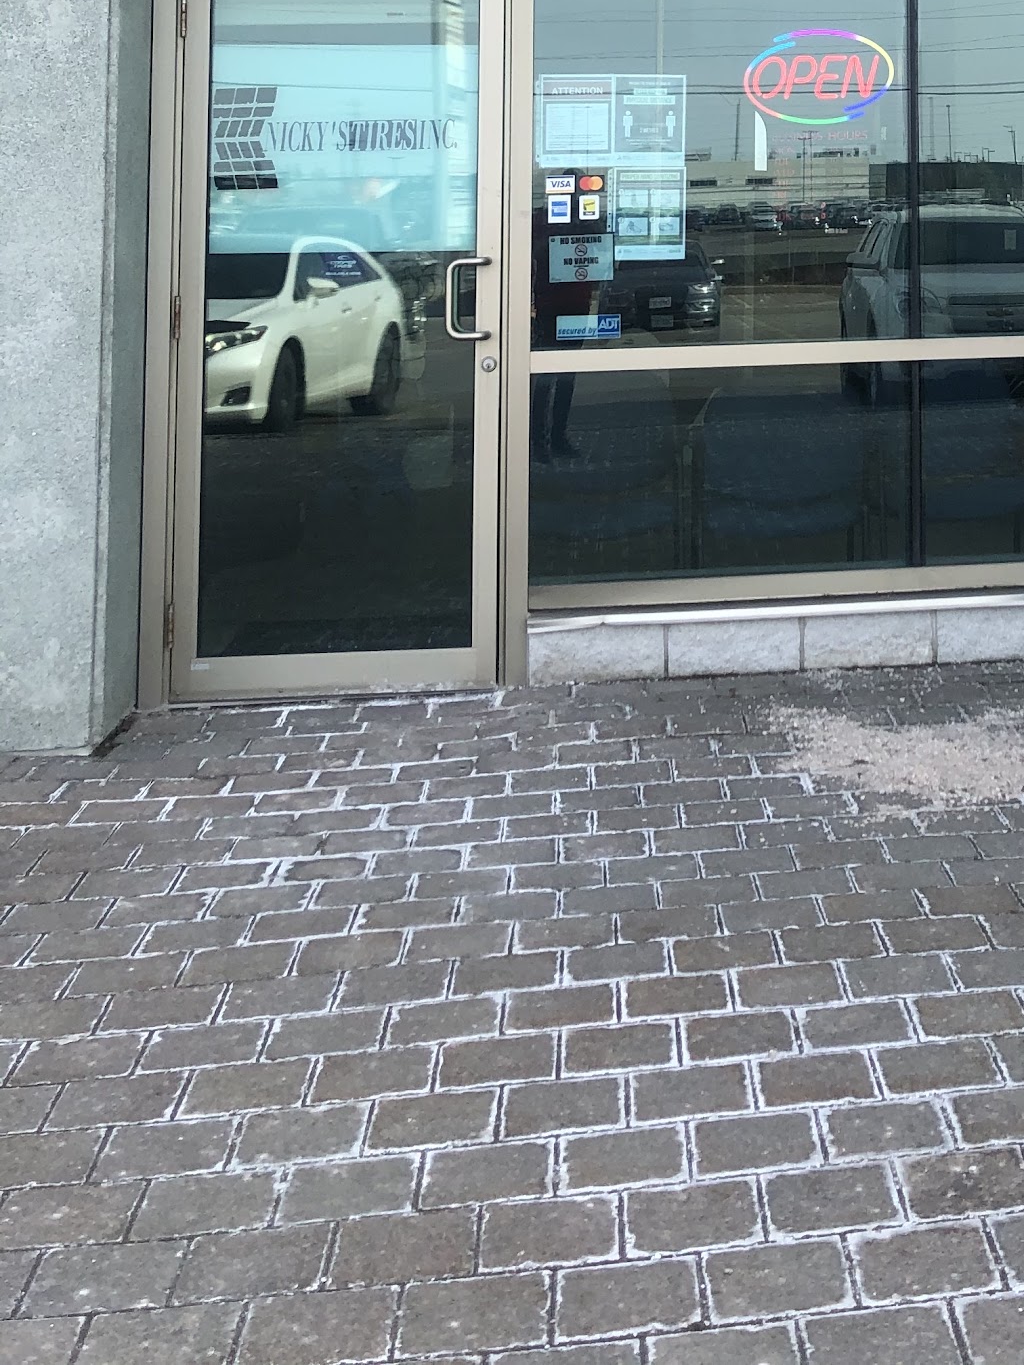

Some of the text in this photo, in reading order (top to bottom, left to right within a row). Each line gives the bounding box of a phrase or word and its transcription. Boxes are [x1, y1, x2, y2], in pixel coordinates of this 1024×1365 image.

[752, 54, 880, 100] OPEN
[551, 86, 604, 95] ATTENTION
[550, 180, 571, 188] VISA
[559, 235, 602, 245] NO SMOKING
[563, 256, 599, 266] NO VAPING
[558, 317, 620, 336] secured by ADT
